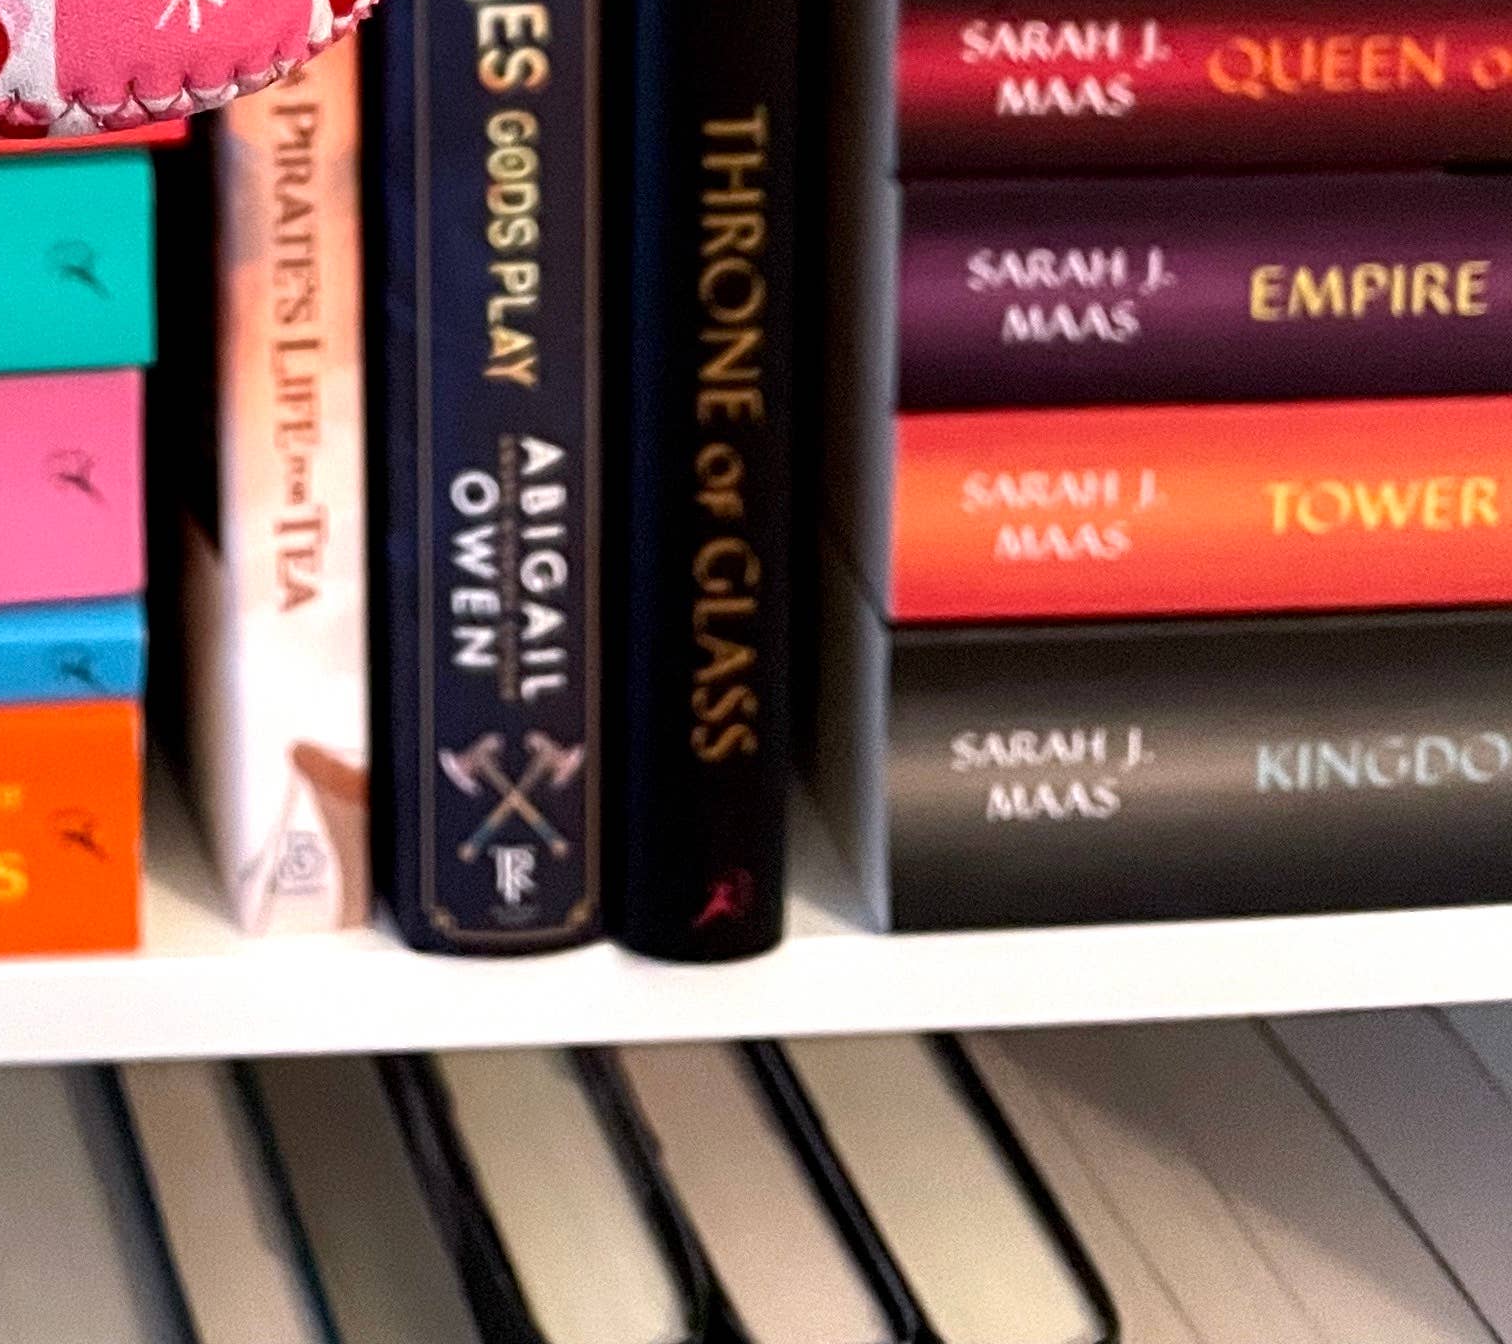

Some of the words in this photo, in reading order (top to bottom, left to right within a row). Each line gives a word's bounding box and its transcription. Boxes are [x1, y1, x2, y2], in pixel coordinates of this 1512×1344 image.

[959, 18, 1123, 65] SARAH
[1136, 17, 1172, 69] J.
[1206, 33, 1445, 101] QUEEN
[996, 72, 1136, 117] MAAS
[486, 110, 541, 252] GODS
[697, 104, 768, 423] THRONE
[966, 247, 1128, 292] SARAH
[1138, 246, 1178, 296] J.
[1250, 260, 1492, 322] EMPIRE
[483, 260, 541, 390] PLAY
[1002, 300, 1141, 345] MAAS
[272, 338, 321, 448] LIFE
[960, 469, 1121, 513] SARAH
[1133, 467, 1169, 515] J.
[1262, 475, 1500, 536] TOWER
[993, 518, 1132, 561] MAAS
[274, 506, 329, 613] TEA
[450, 468, 502, 671] OWEN
[519, 436, 569, 703] ABIGAIL
[690, 534, 763, 763] GLASS
[950, 727, 1107, 773] SARAH
[1119, 726, 1156, 773] J.
[1254, 731, 1512, 794] KINGDO
[987, 778, 1123, 823] MAAS
